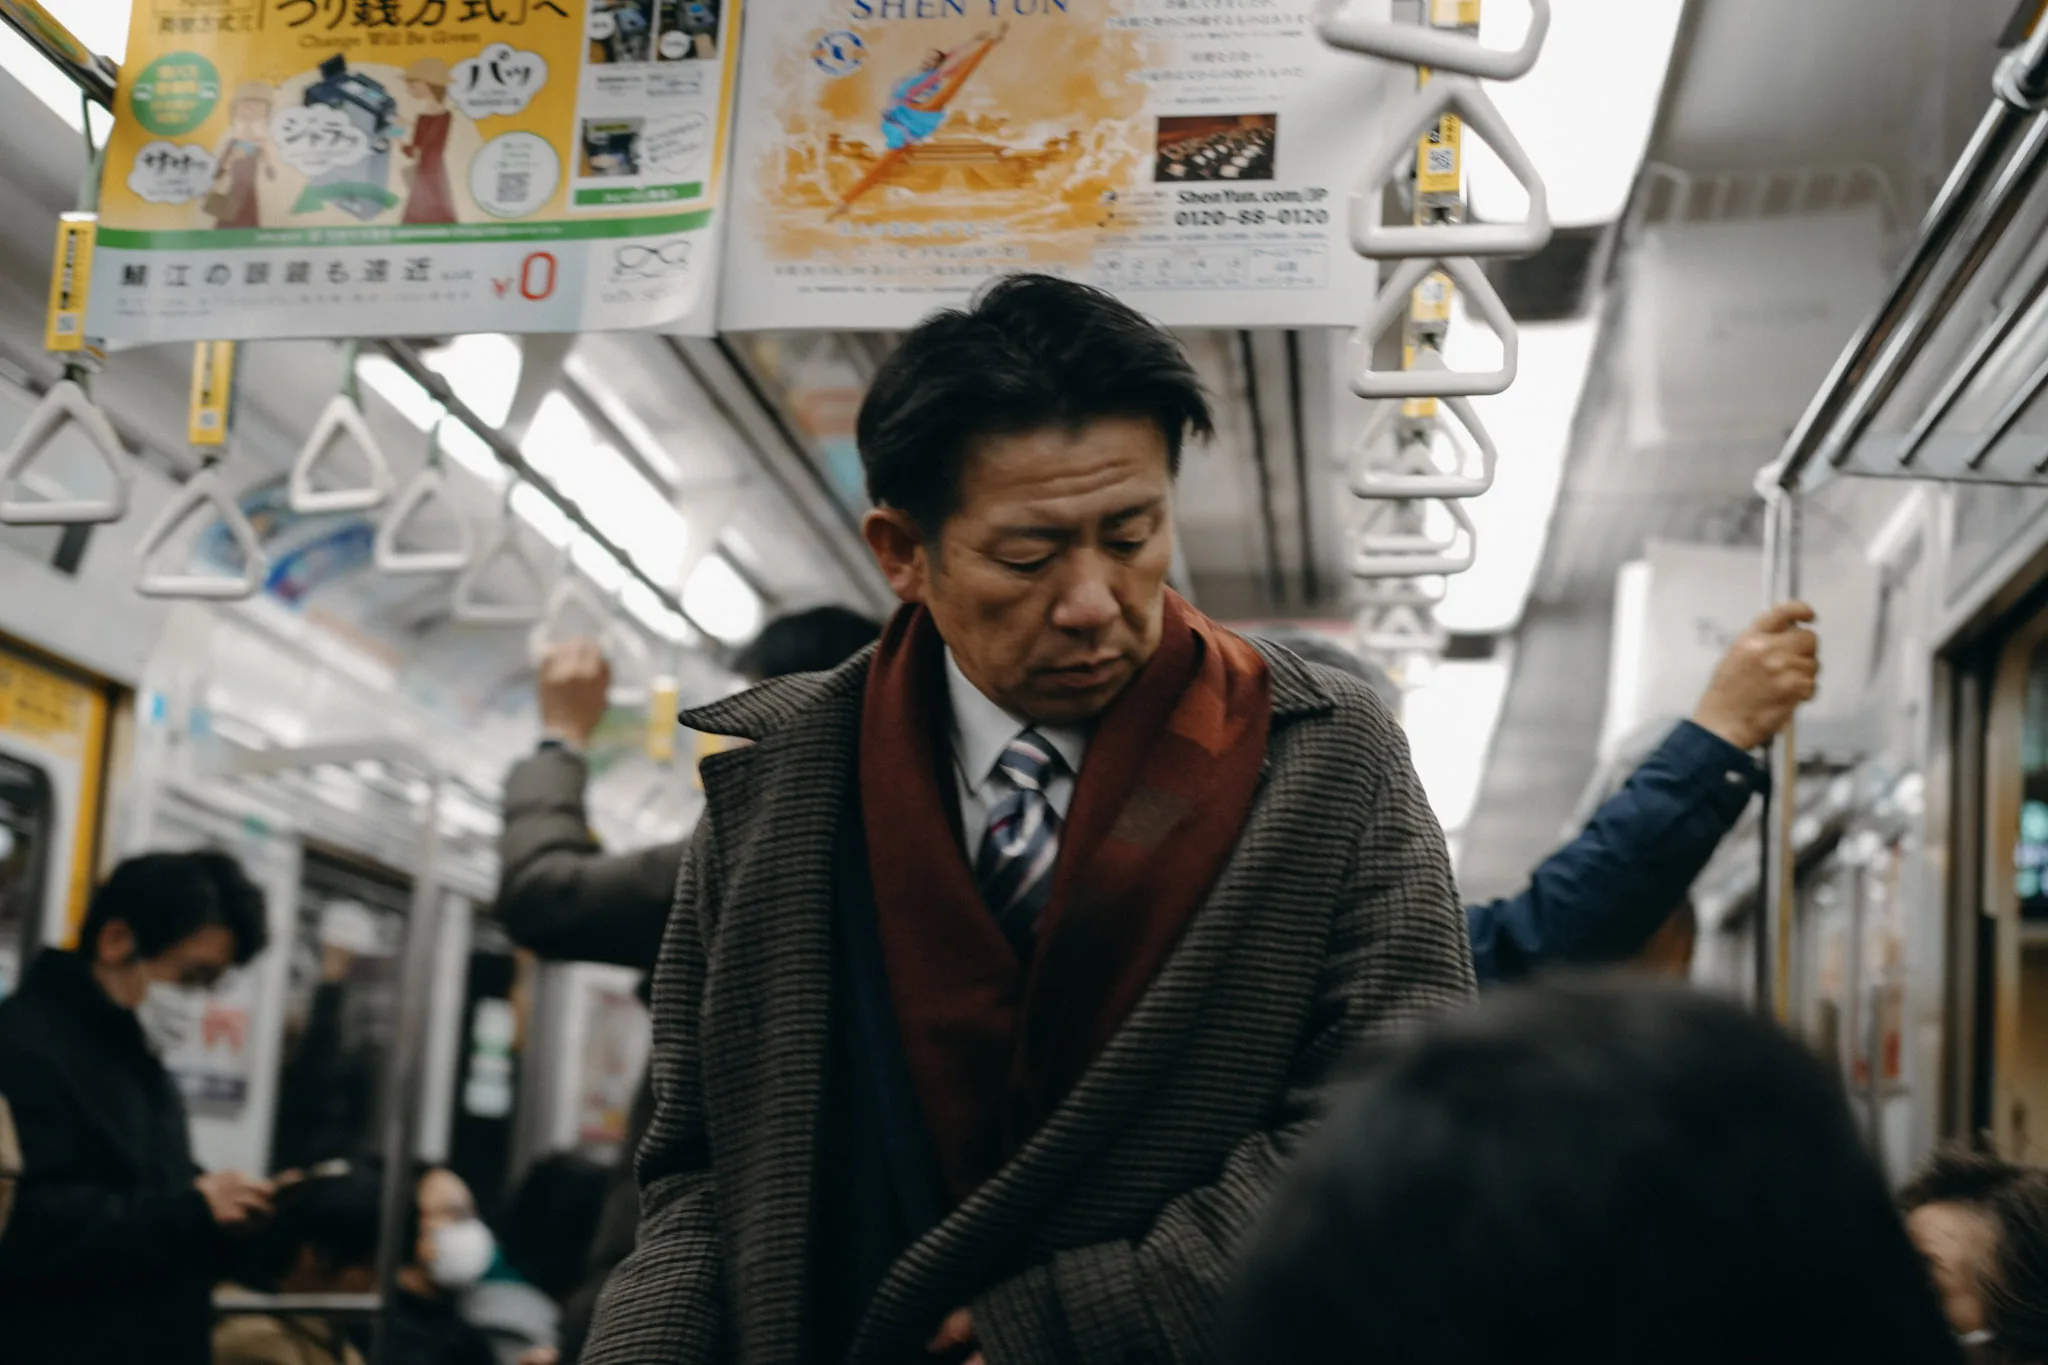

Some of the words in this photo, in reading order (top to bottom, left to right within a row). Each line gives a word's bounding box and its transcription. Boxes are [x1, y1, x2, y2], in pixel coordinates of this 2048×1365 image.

[852, 0, 965, 20] SHEN
[988, 0, 1069, 17] YUN
[299, 34, 361, 48] Change
[367, 31, 400, 46] Will
[405, 31, 426, 45] Be
[431, 31, 480, 44] Given
[466, 50, 531, 90] パッ
[1176, 187, 1330, 205] ShenYun.com/JP
[1174, 208, 1330, 227] 0120-88-0120
